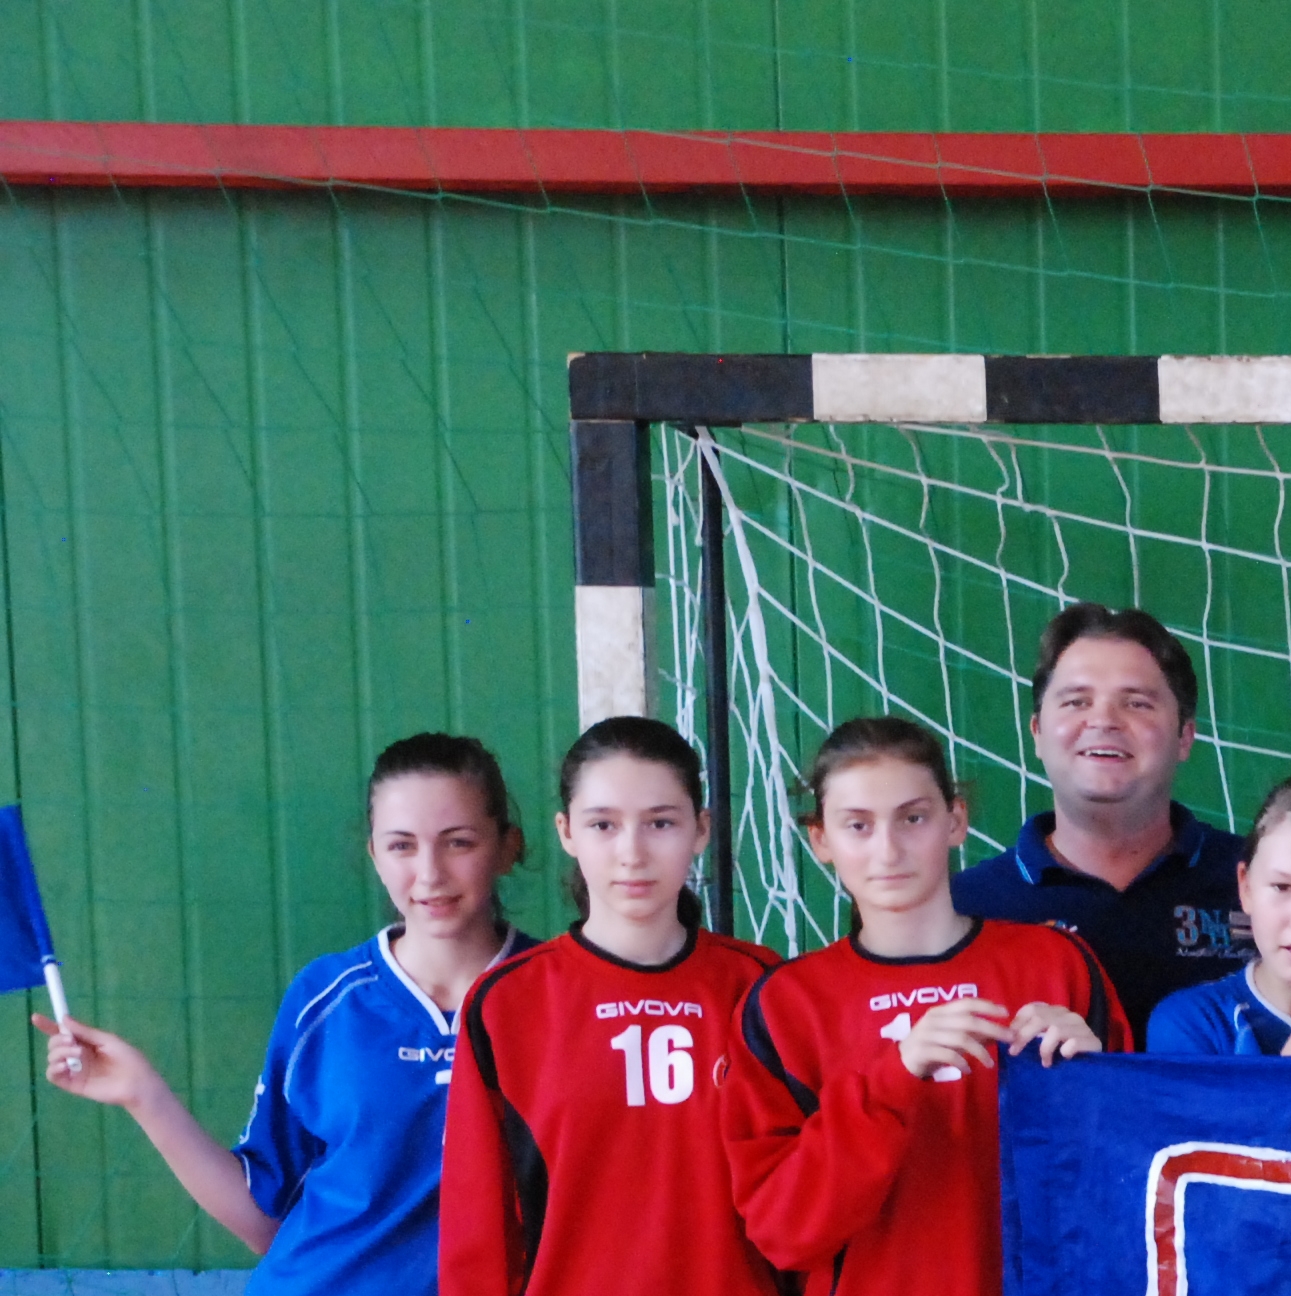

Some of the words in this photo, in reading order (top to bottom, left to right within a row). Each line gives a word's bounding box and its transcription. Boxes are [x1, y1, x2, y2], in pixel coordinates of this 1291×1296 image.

[595, 999, 703, 1018] GIVOVA
[869, 983, 978, 1012] GIVOVA
[398, 1046, 456, 1063] GIVO
[610, 1024, 694, 1106] 16
